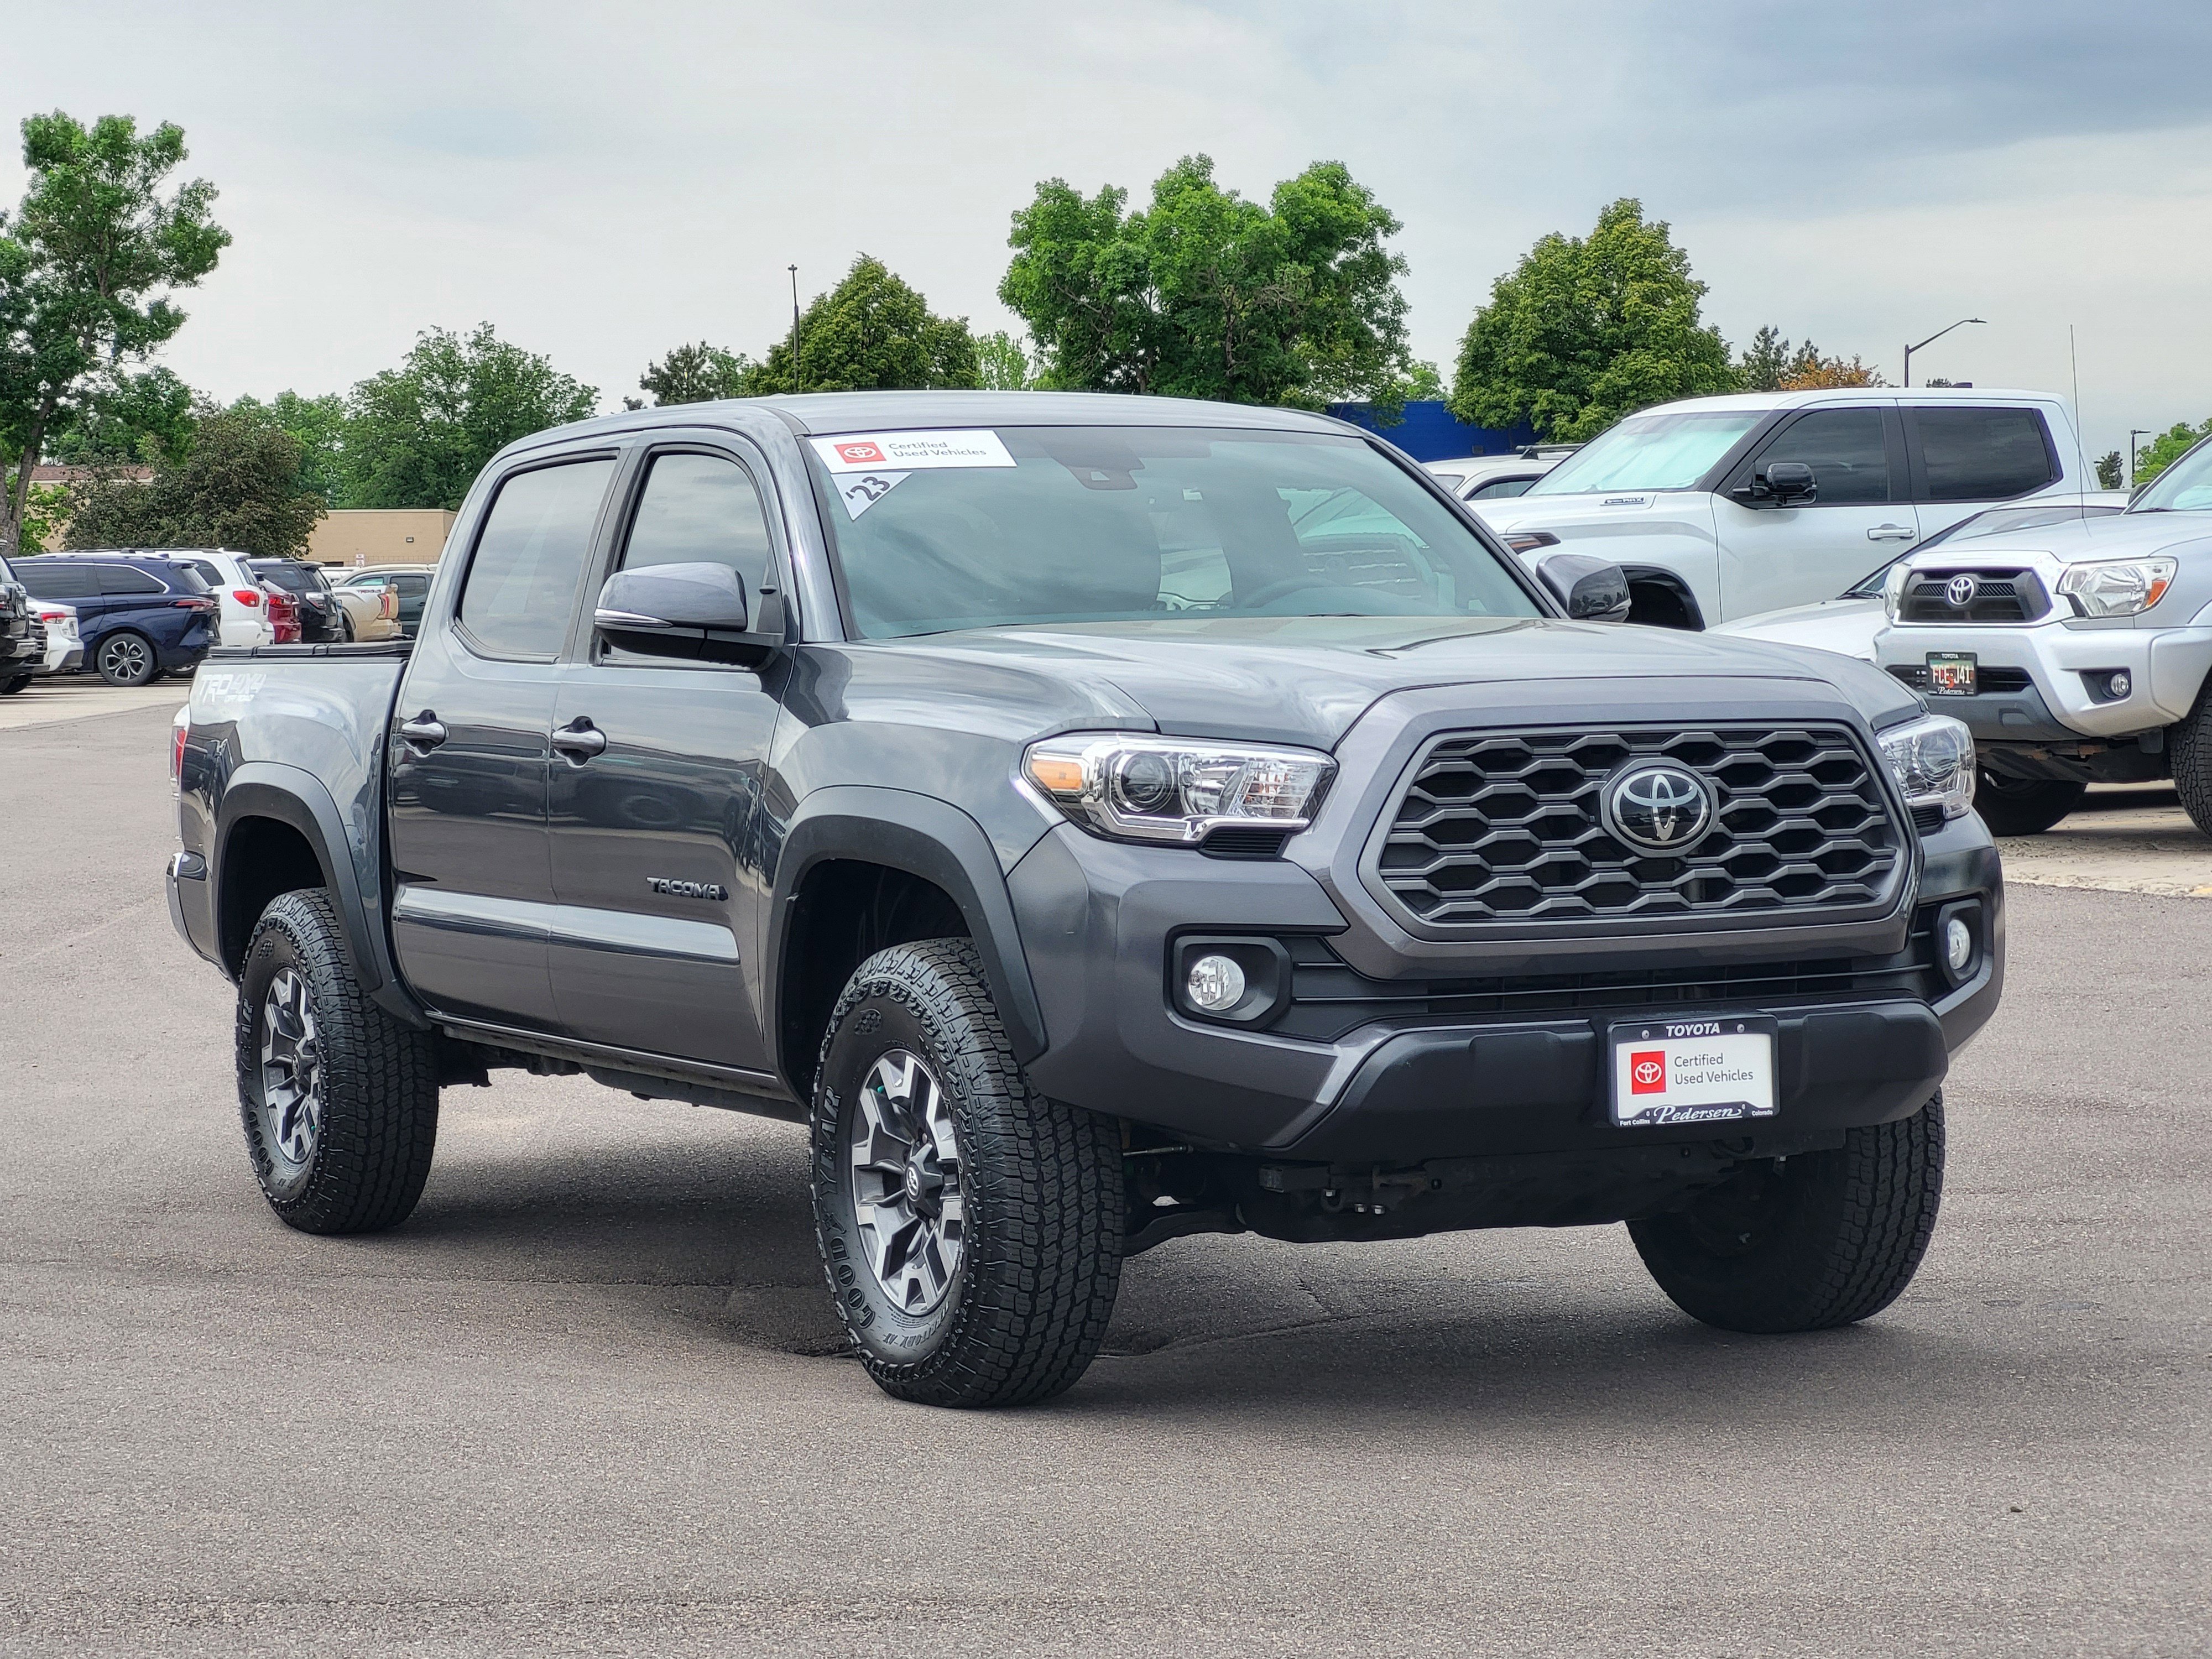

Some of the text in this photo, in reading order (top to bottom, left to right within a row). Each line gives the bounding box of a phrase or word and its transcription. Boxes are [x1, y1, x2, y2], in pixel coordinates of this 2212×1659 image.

[646, 877, 721, 900] TACOMA
[1666, 1022, 1720, 1037] TOYOTA
[1674, 1052, 1723, 1067] Certified
[1674, 1070, 1754, 1085] Used Vehicles
[1653, 1105, 1742, 1124] Pedersen
